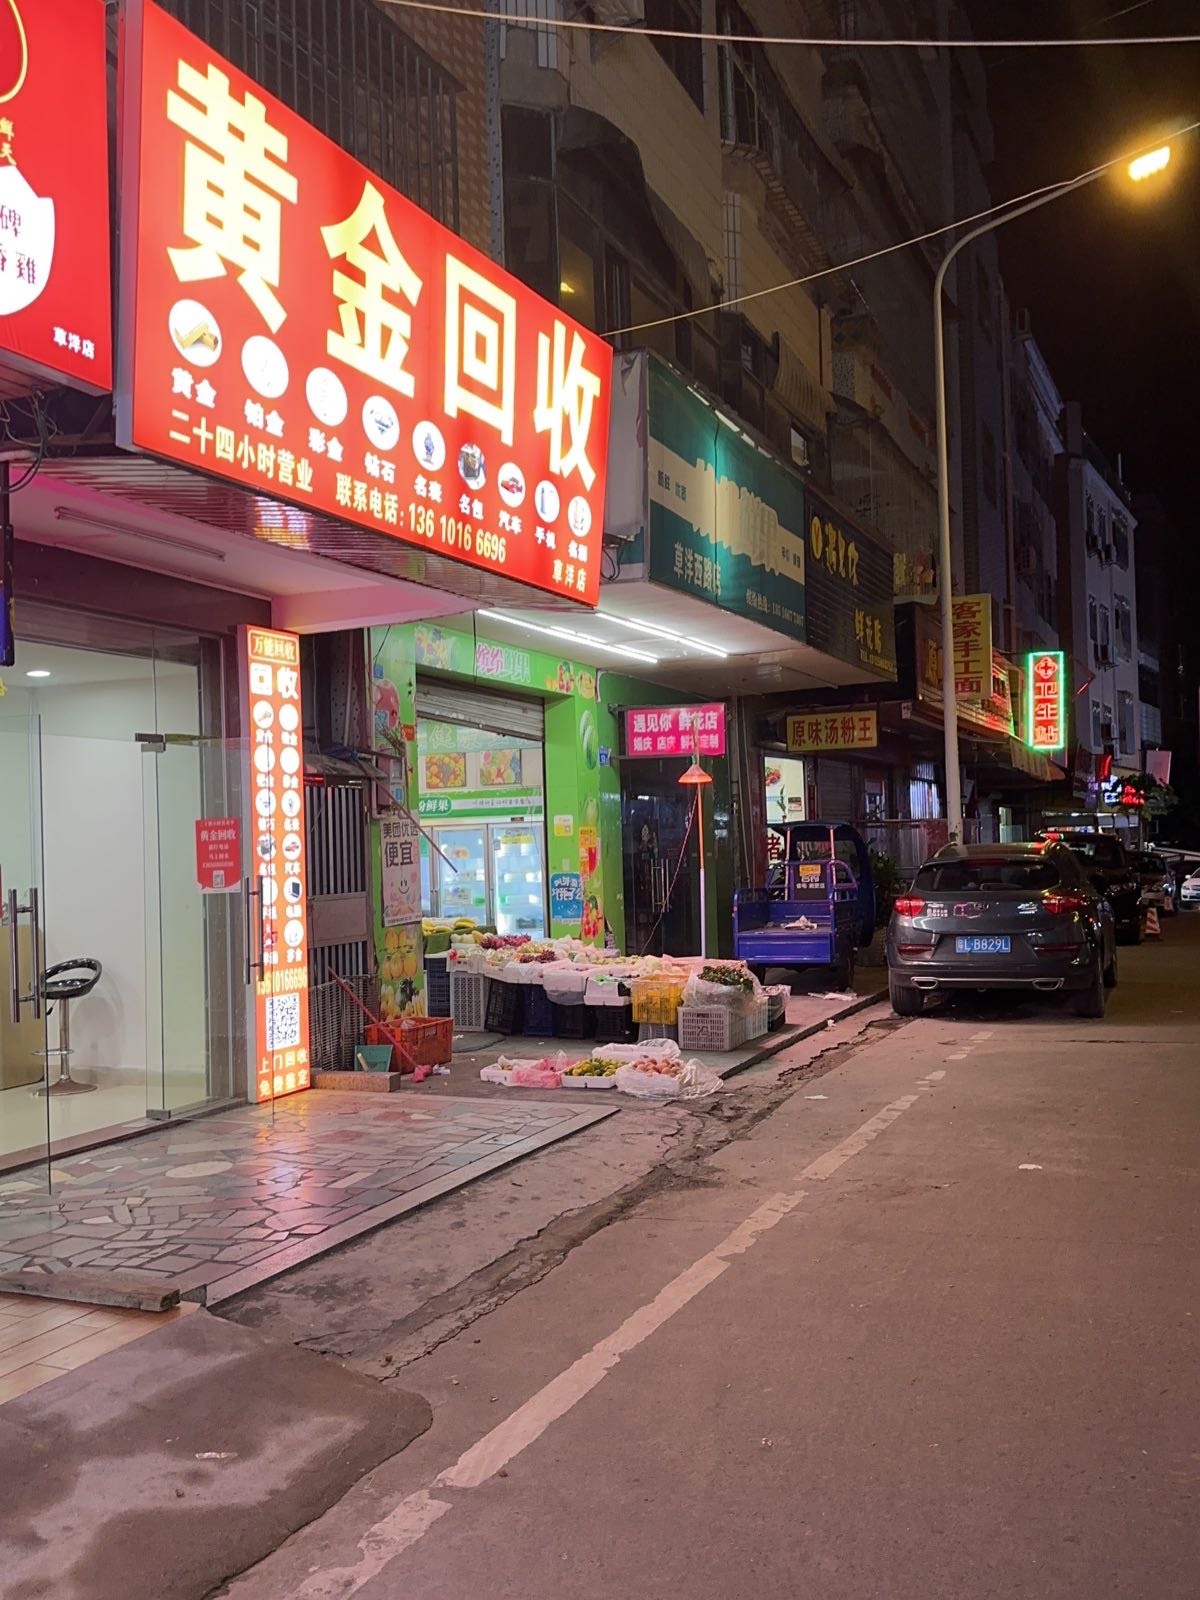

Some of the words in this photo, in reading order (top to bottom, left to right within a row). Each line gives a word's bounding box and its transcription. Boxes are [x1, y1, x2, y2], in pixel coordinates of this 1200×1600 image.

[167, 59, 601, 491] 黄金回收
[171, 367, 217, 409] 黄金
[244, 398, 285, 438] 铂金
[308, 427, 344, 463] 彩金
[364, 451, 396, 484] 钻石
[414, 474, 442, 503] 名表
[459, 493, 484, 520] 名包
[498, 509, 522, 535] 汽车
[535, 526, 556, 550] 手机
[169, 409, 313, 493] 二十四小时营业
[408, 502, 435, 538] 136
[440, 515, 472, 551] 1016
[476, 528, 506, 564] 6696
[552, 558, 587, 593] 草洋店
[476, 641, 530, 684] 缤纷鲜果
[952, 602, 983, 694] 客家手工面
[250, 662, 299, 700] 回收
[633, 713, 672, 733] 遇见你
[678, 709, 718, 732] 鲜花店
[792, 716, 873, 747] 原味汤粉王
[1034, 682, 1059, 743] 卫生站
[384, 840, 414, 868] 便宜
[259, 1047, 307, 1075] 上门回收
[259, 1068, 309, 1097] 免费鉴定
